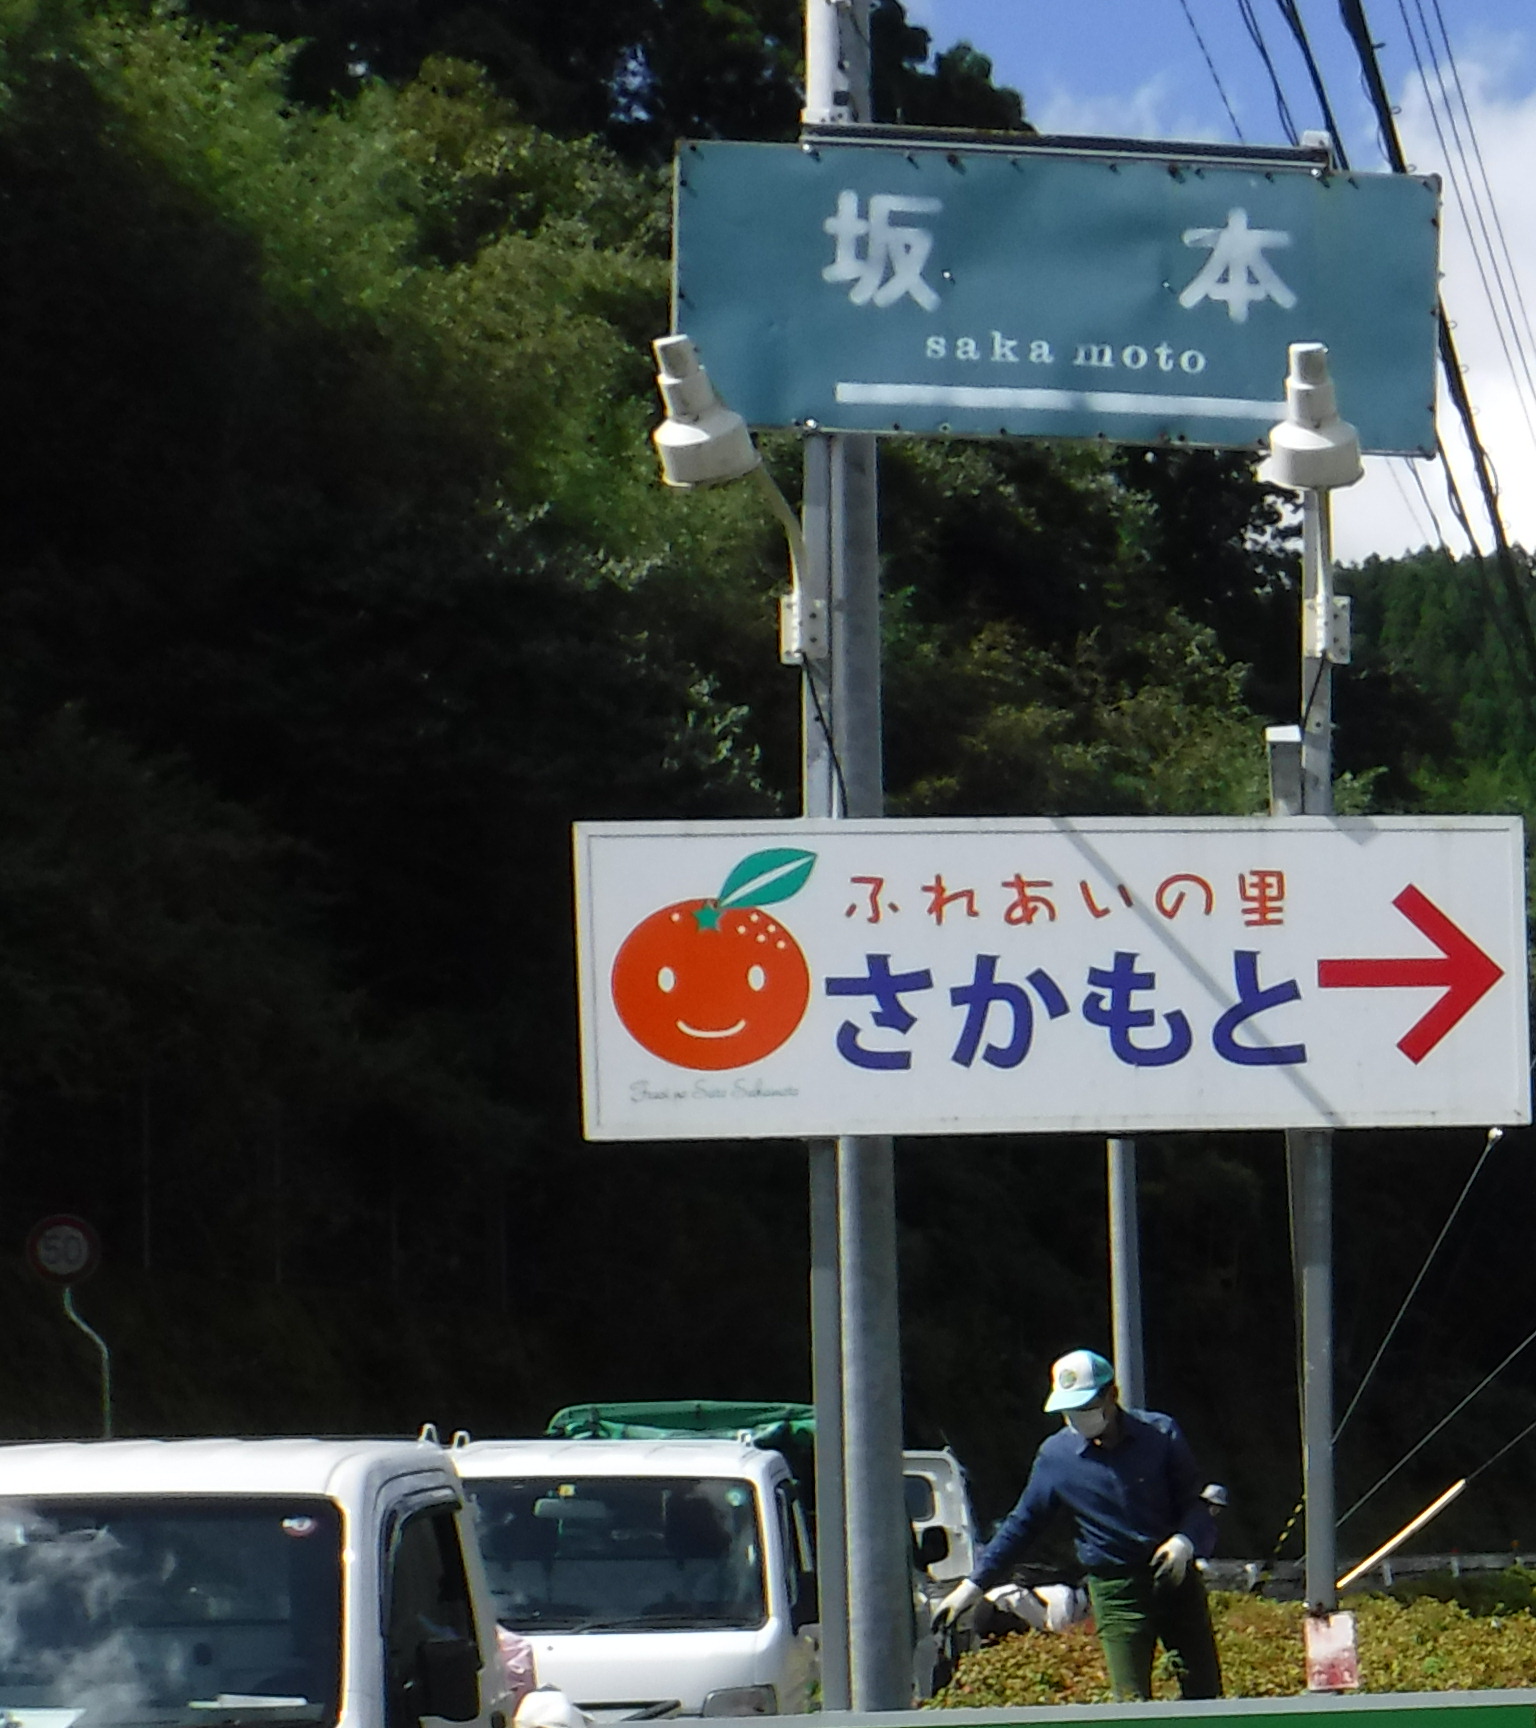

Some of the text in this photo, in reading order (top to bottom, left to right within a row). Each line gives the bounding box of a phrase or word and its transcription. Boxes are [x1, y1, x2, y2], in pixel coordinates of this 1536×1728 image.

[926, 329, 1207, 375] saka moto
[843, 870, 1289, 927] ふれあいの里
[824, 950, 1308, 1071] さかもと
[42, 1233, 83, 1266] 50
